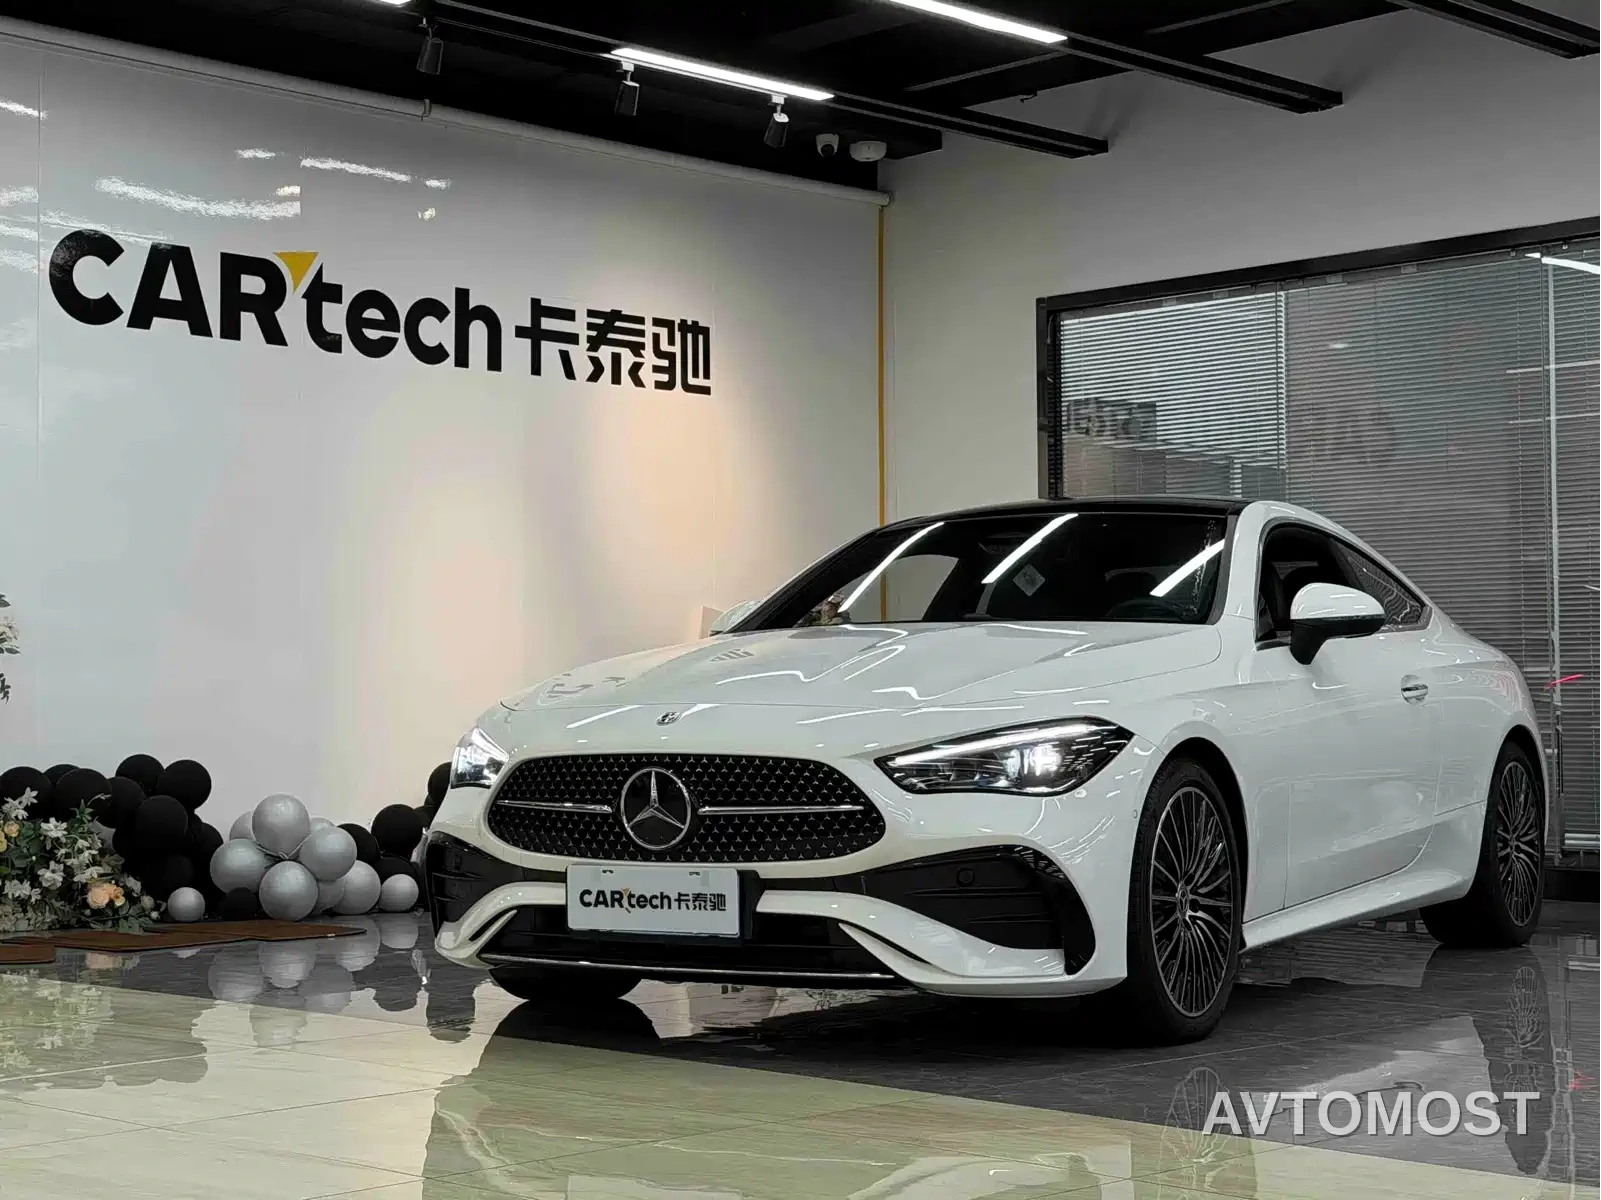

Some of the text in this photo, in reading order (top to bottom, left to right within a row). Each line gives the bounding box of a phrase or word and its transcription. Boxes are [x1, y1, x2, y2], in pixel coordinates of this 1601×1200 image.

[49, 229, 711, 396] CARtech 卡泰驰
[579, 889, 727, 911] CARtech 卡泰驰
